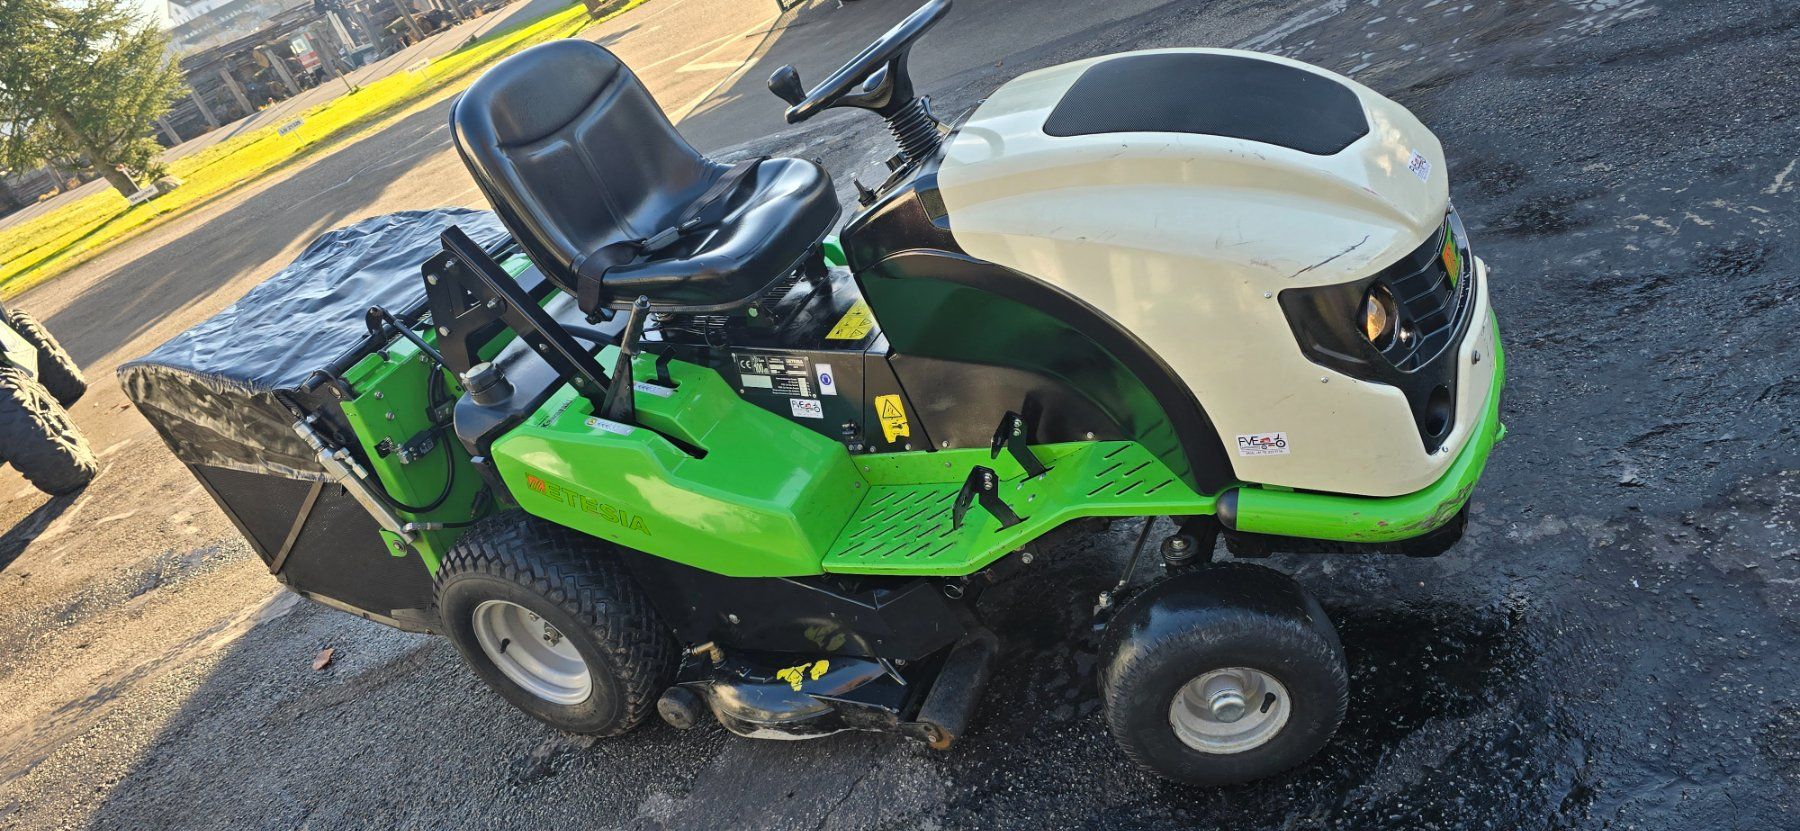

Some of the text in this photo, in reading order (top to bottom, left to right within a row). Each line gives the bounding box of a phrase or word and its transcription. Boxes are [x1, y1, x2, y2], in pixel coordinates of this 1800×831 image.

[740, 360, 752, 369] CE
[1238, 436, 1259, 447] FVE
[547, 482, 652, 536] ETESIA
